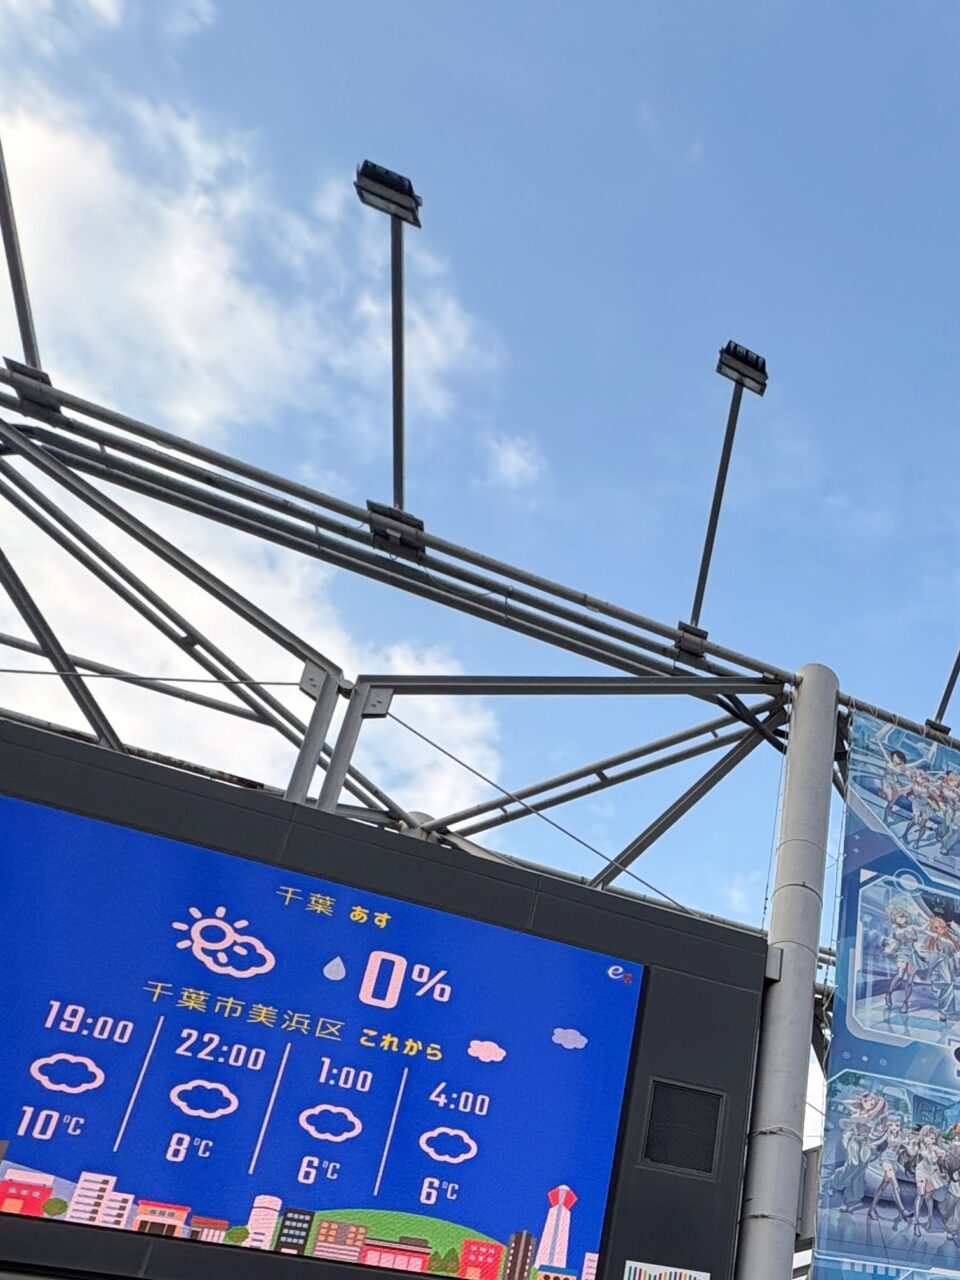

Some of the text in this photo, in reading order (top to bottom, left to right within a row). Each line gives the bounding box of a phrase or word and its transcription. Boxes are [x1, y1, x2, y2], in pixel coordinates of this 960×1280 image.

[275, 885, 392, 929] 千葉 あす
[358, 950, 452, 1010] 0%
[44, 1000, 134, 1044] 19:00
[143, 980, 444, 1062] 千葉市美浜区 これから
[175, 1028, 266, 1071] 22:00
[318, 1056, 373, 1093] 1:00
[428, 1081, 490, 1116] 4:00
